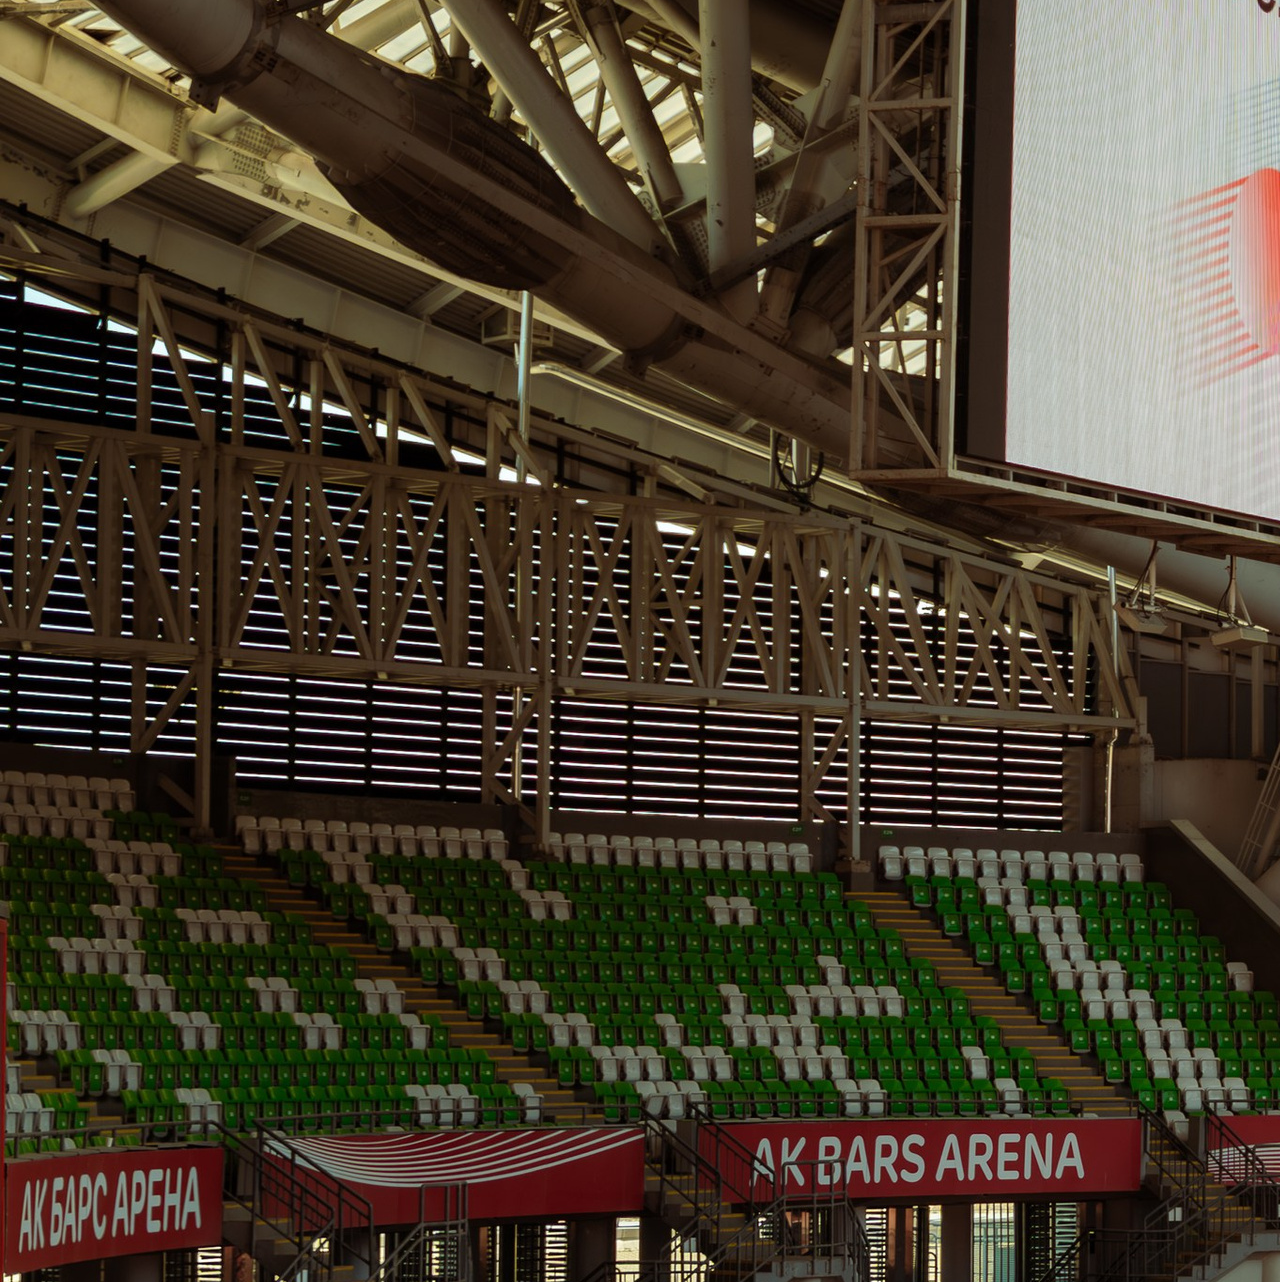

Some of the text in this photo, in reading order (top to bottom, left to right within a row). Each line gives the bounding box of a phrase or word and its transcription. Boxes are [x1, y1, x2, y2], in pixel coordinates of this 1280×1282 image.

[750, 1132, 1085, 1186] AK BARS ARENA
[18, 1166, 202, 1254] АК БАРС АРЕНА
